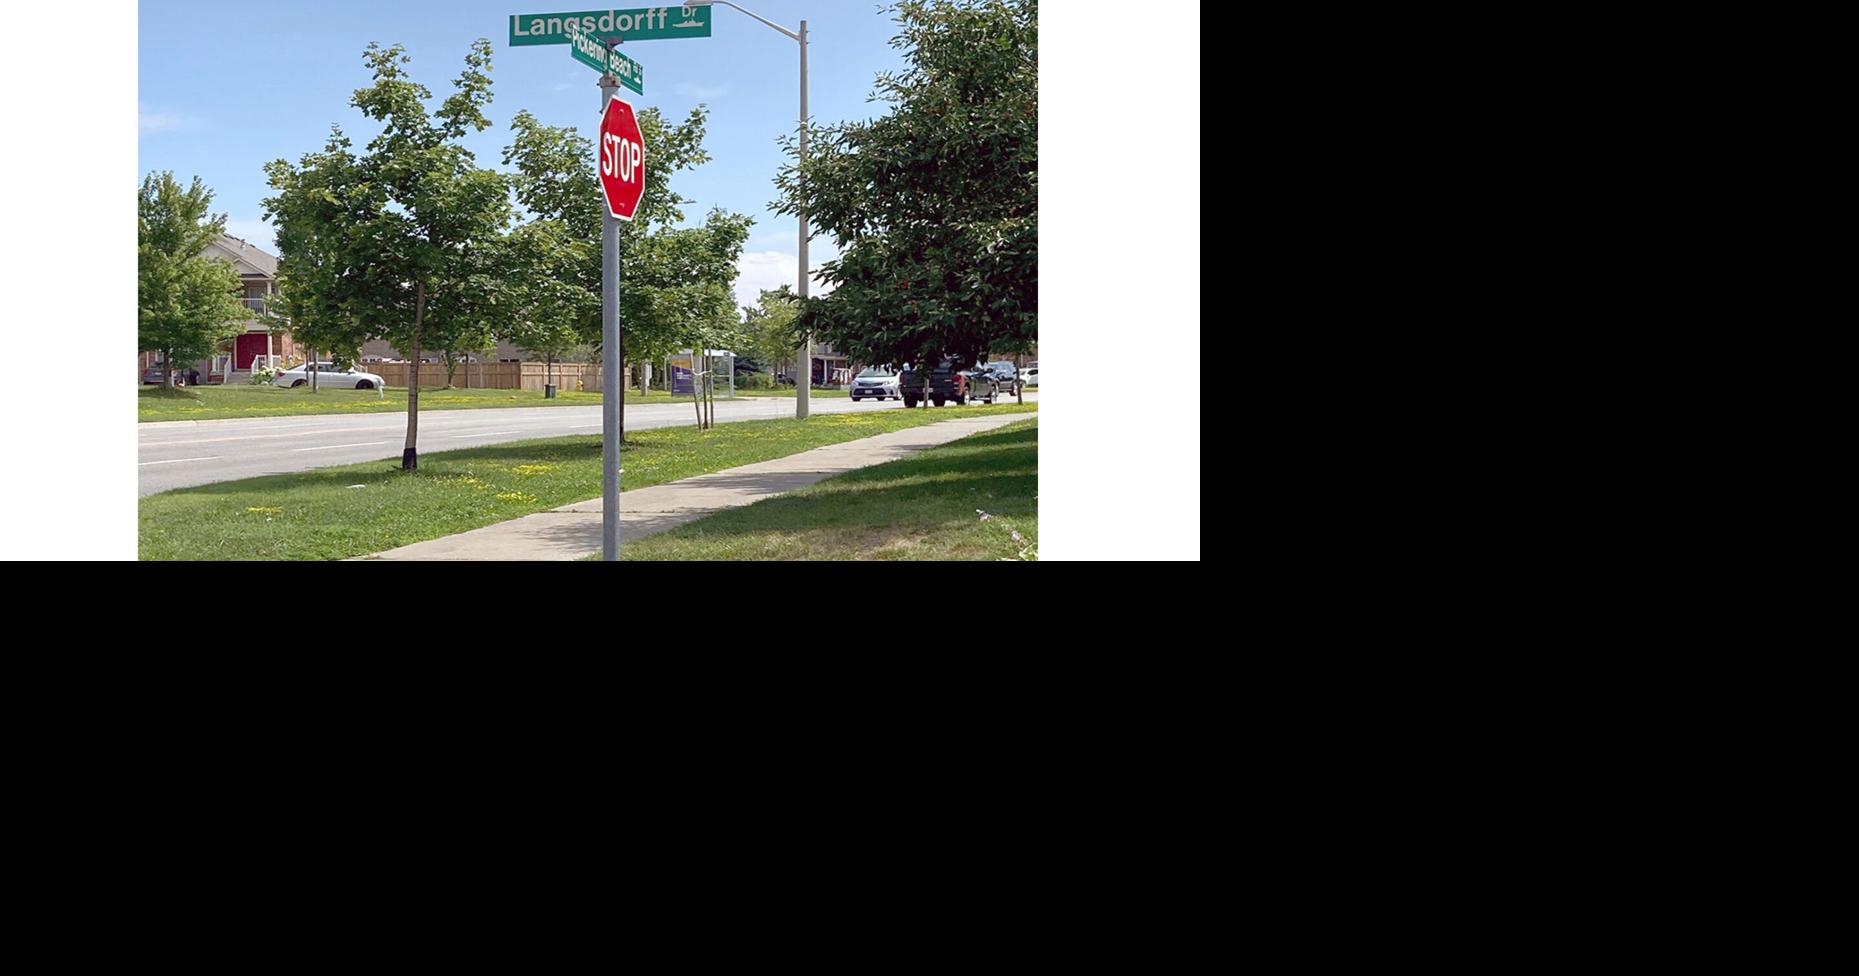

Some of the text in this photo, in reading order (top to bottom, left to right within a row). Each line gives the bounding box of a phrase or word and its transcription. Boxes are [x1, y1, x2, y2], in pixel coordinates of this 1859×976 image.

[514, 7, 697, 38] Langsdorff Dr
[603, 132, 640, 184] STOP
